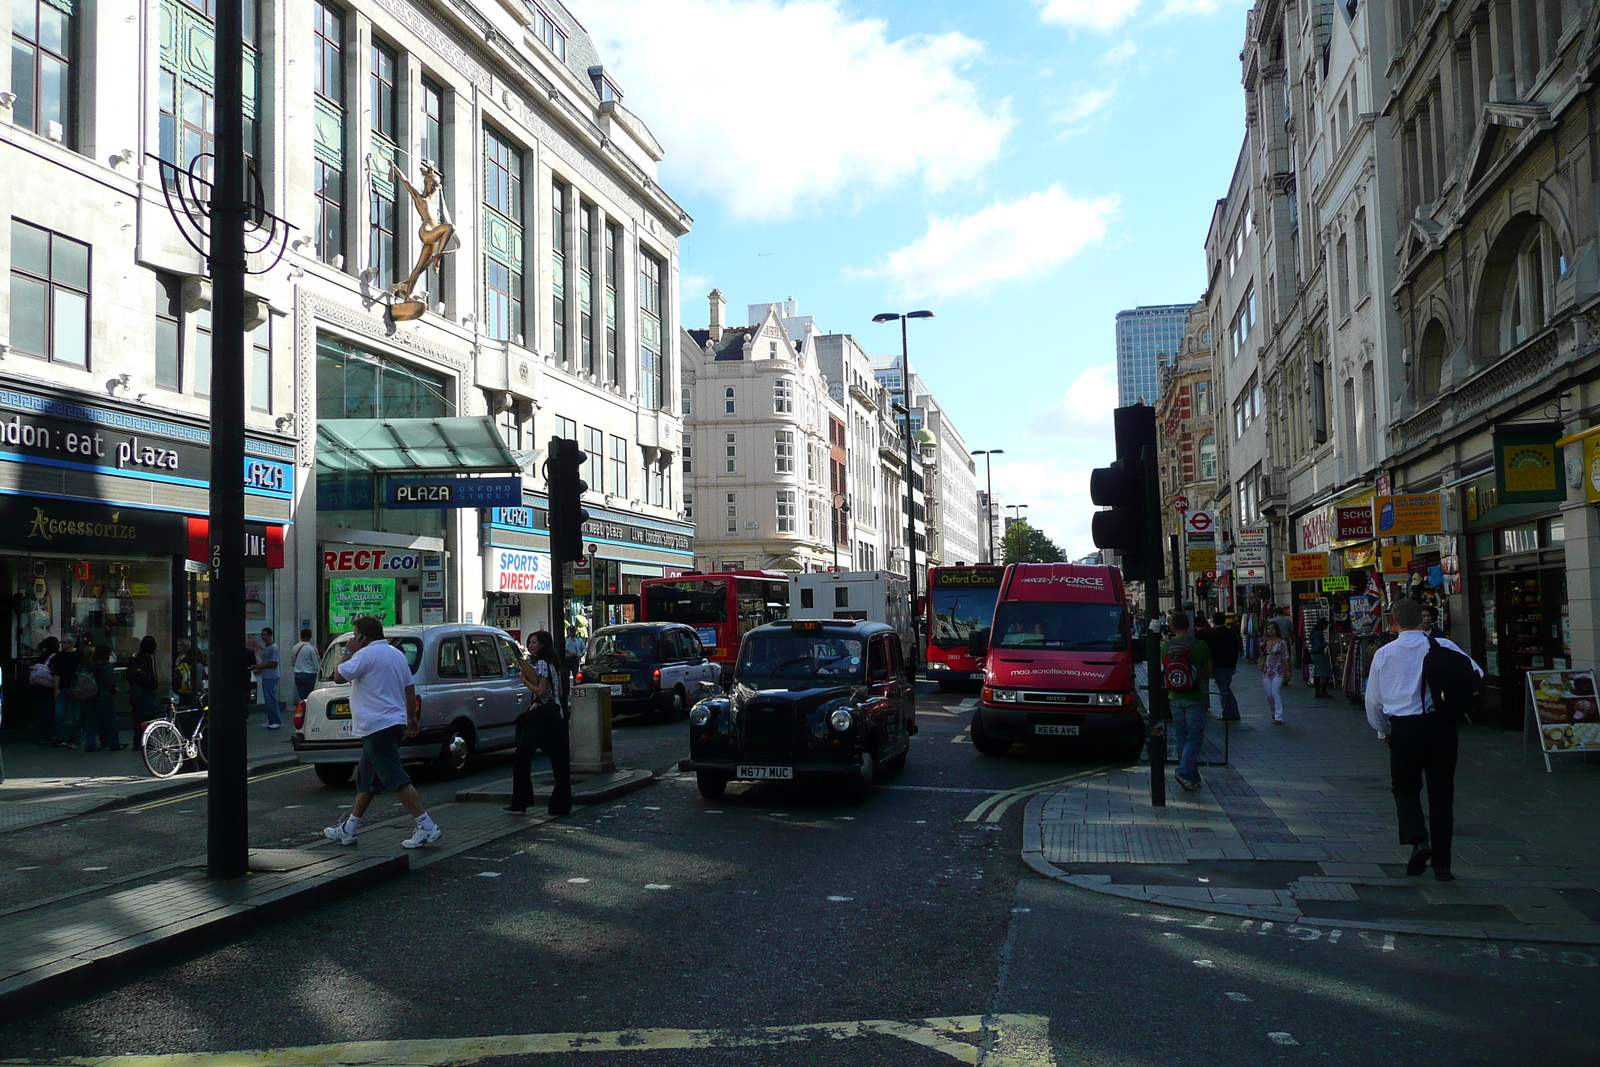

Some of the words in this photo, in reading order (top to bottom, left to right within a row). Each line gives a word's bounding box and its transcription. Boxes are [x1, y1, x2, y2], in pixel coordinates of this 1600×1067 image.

[118, 437, 179, 469] plaza
[244, 461, 285, 488] AZA
[398, 485, 450, 502] PLAZA
[459, 485, 511, 493] OXFORD
[459, 492, 511, 500] STREET
[1174, 499, 1188, 509] ON
[500, 507, 528, 525] PLAZA
[28, 506, 136, 540] Accessorize
[499, 552, 539, 572] SPORTS
[1291, 564, 1323, 572] CHANGE
[941, 574, 969, 584] Oxford
[970, 574, 995, 584] Circus
[353, 583, 382, 592] MASSIVE
[740, 766, 767, 777] M677
[769, 767, 789, 778] MUC
